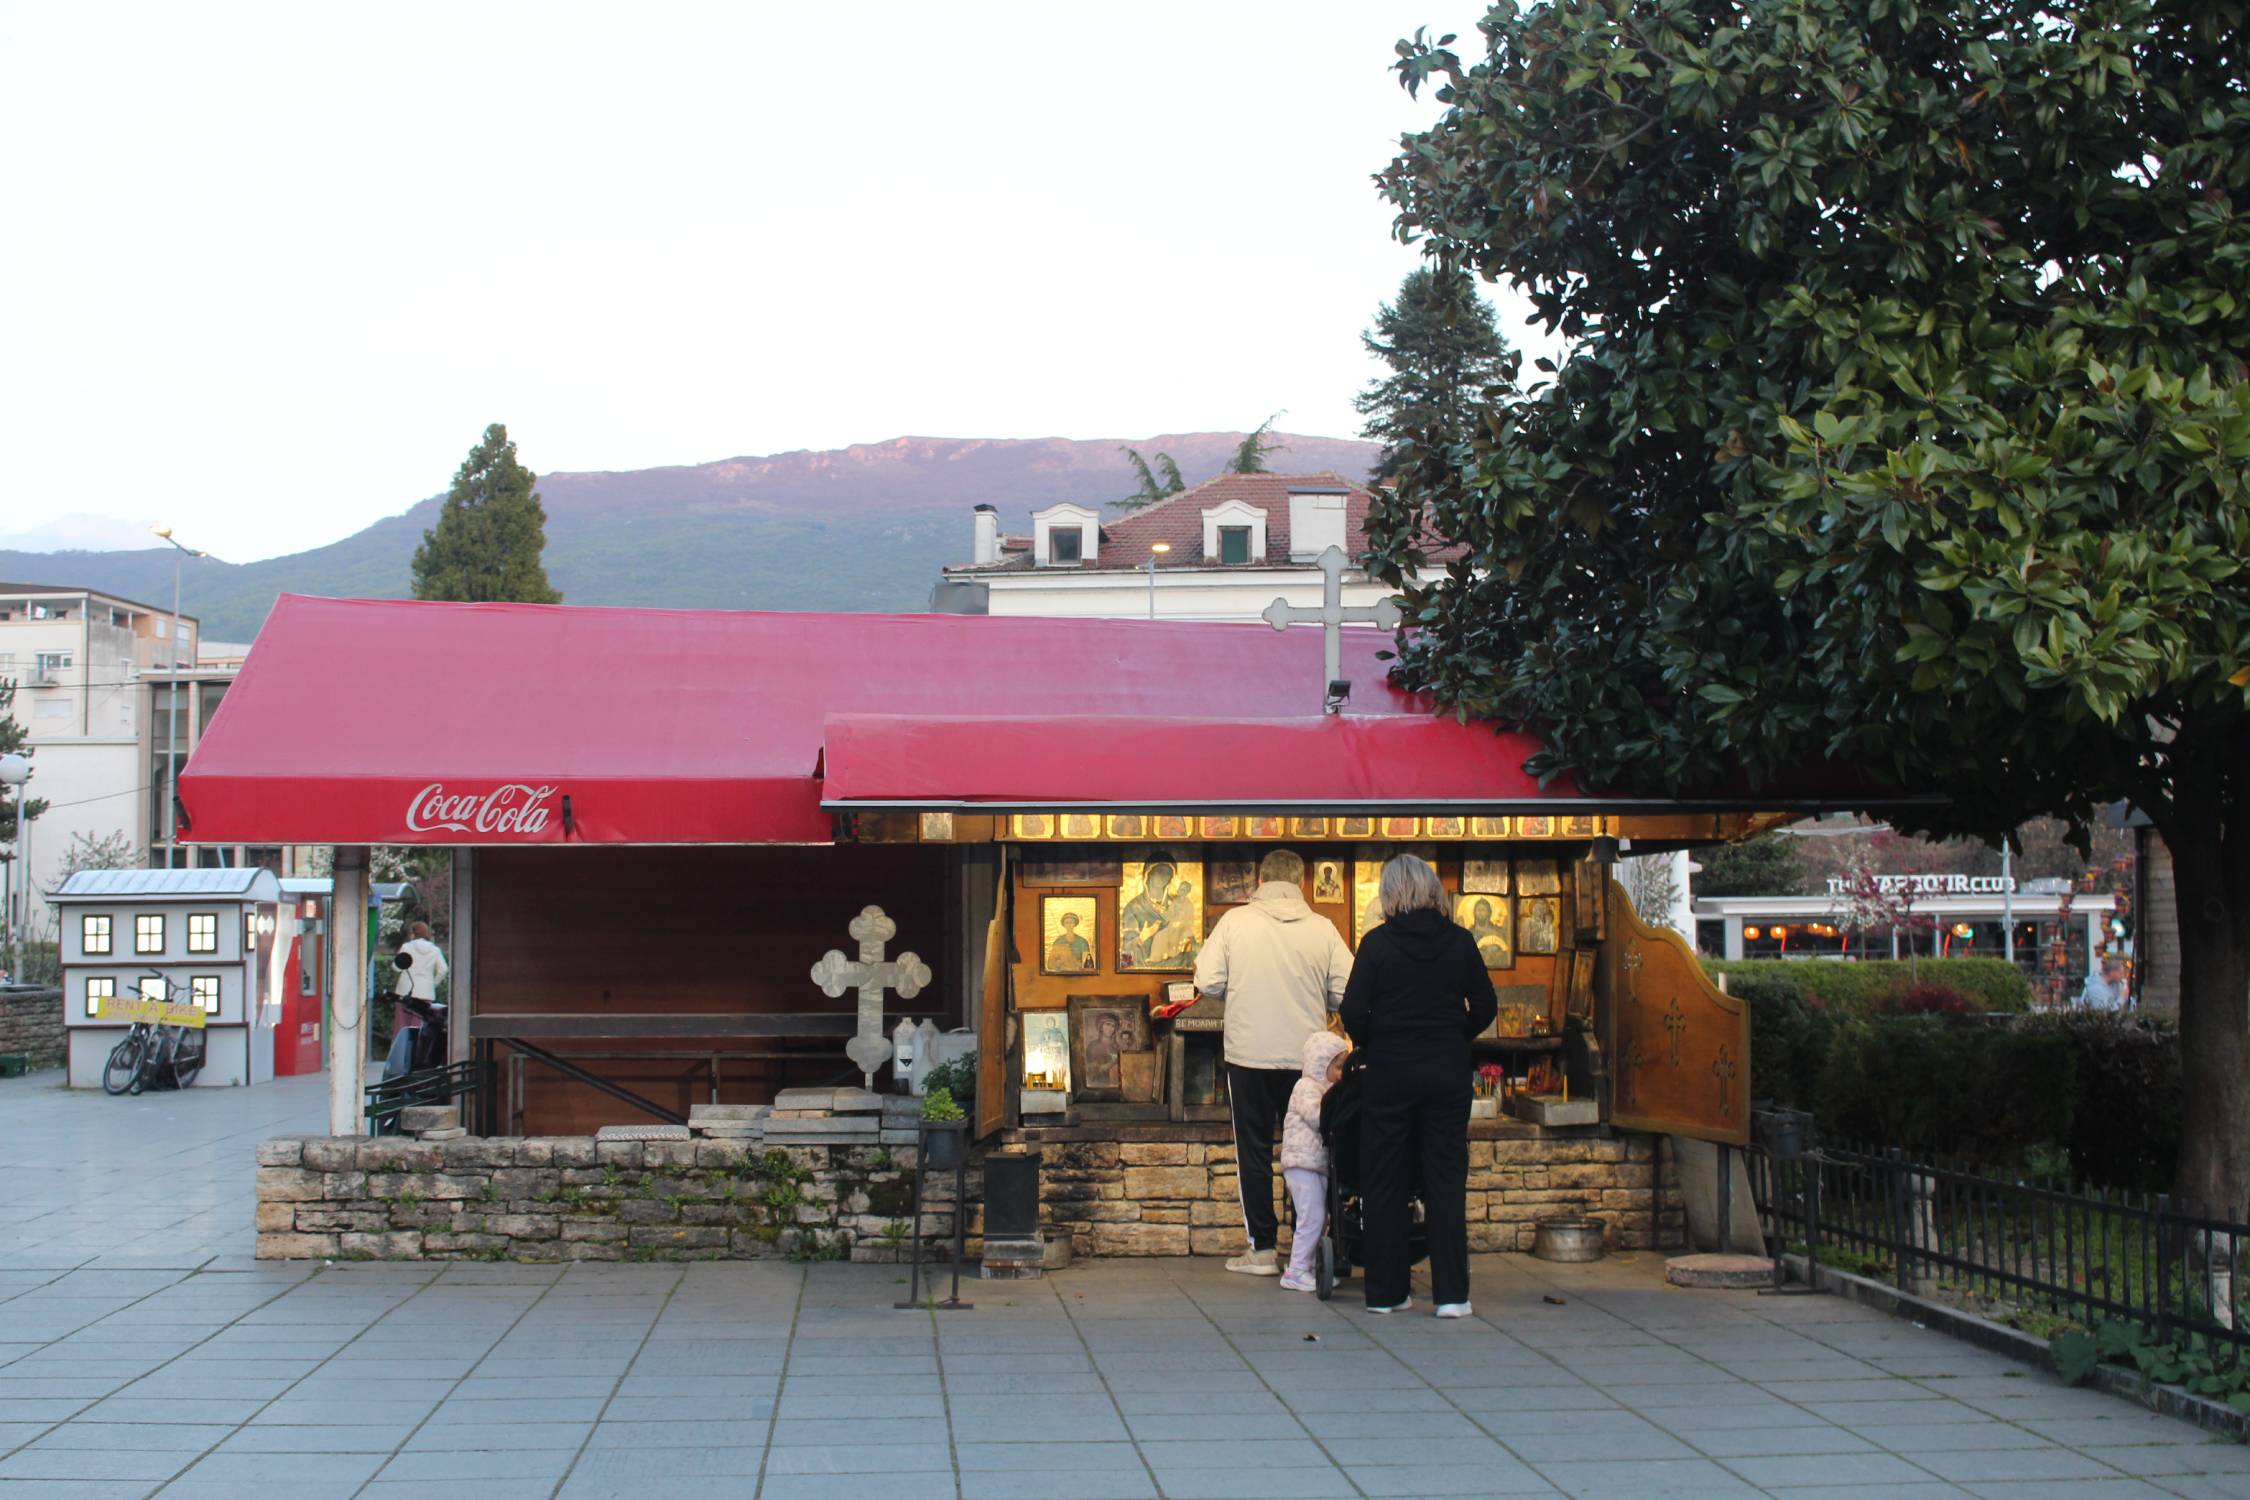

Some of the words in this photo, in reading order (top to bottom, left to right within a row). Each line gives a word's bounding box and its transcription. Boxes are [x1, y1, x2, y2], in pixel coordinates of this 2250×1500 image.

[406, 783, 559, 833] Coca-Cola
[106, 998, 143, 1012] RENT
[150, 1000, 160, 1013] A
[166, 1003, 197, 1017] BIKE
